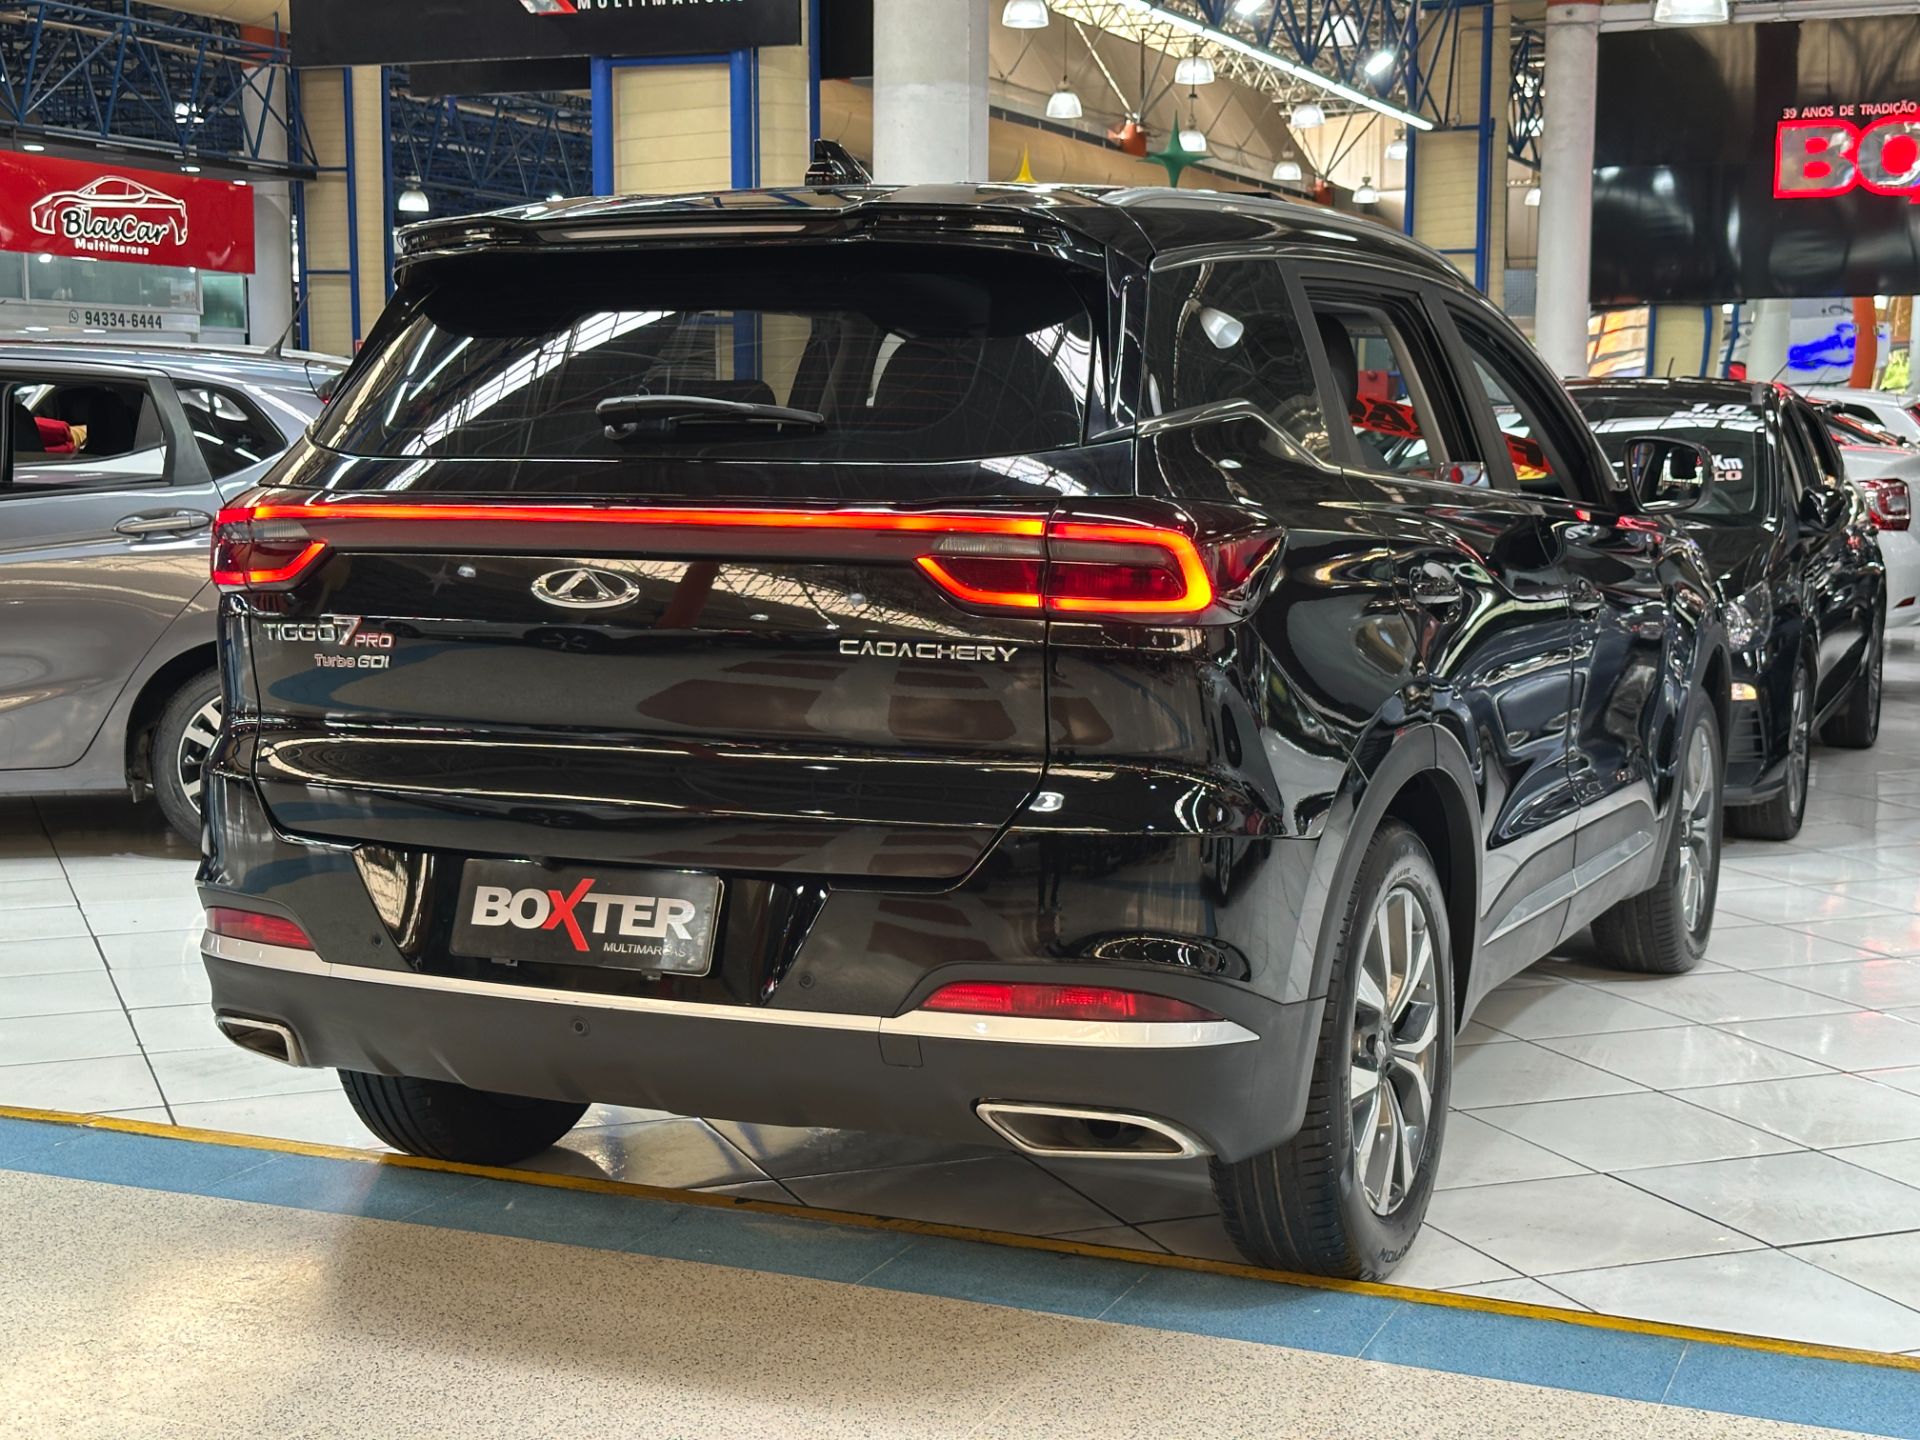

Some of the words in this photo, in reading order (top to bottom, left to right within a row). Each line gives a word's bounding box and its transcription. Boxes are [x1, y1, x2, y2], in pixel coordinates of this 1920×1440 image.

[1783, 108, 1797, 119] 39
[1802, 106, 1834, 118] ANOS
[1839, 105, 1855, 116] DE
[1860, 100, 1917, 116] TRADIÇÃO
[61, 206, 169, 245] BlasCar
[75, 238, 150, 255] Multimarcas
[85, 310, 162, 329] 94334-6444
[314, 653, 355, 668] Turbo
[471, 878, 696, 951] BOXTER
